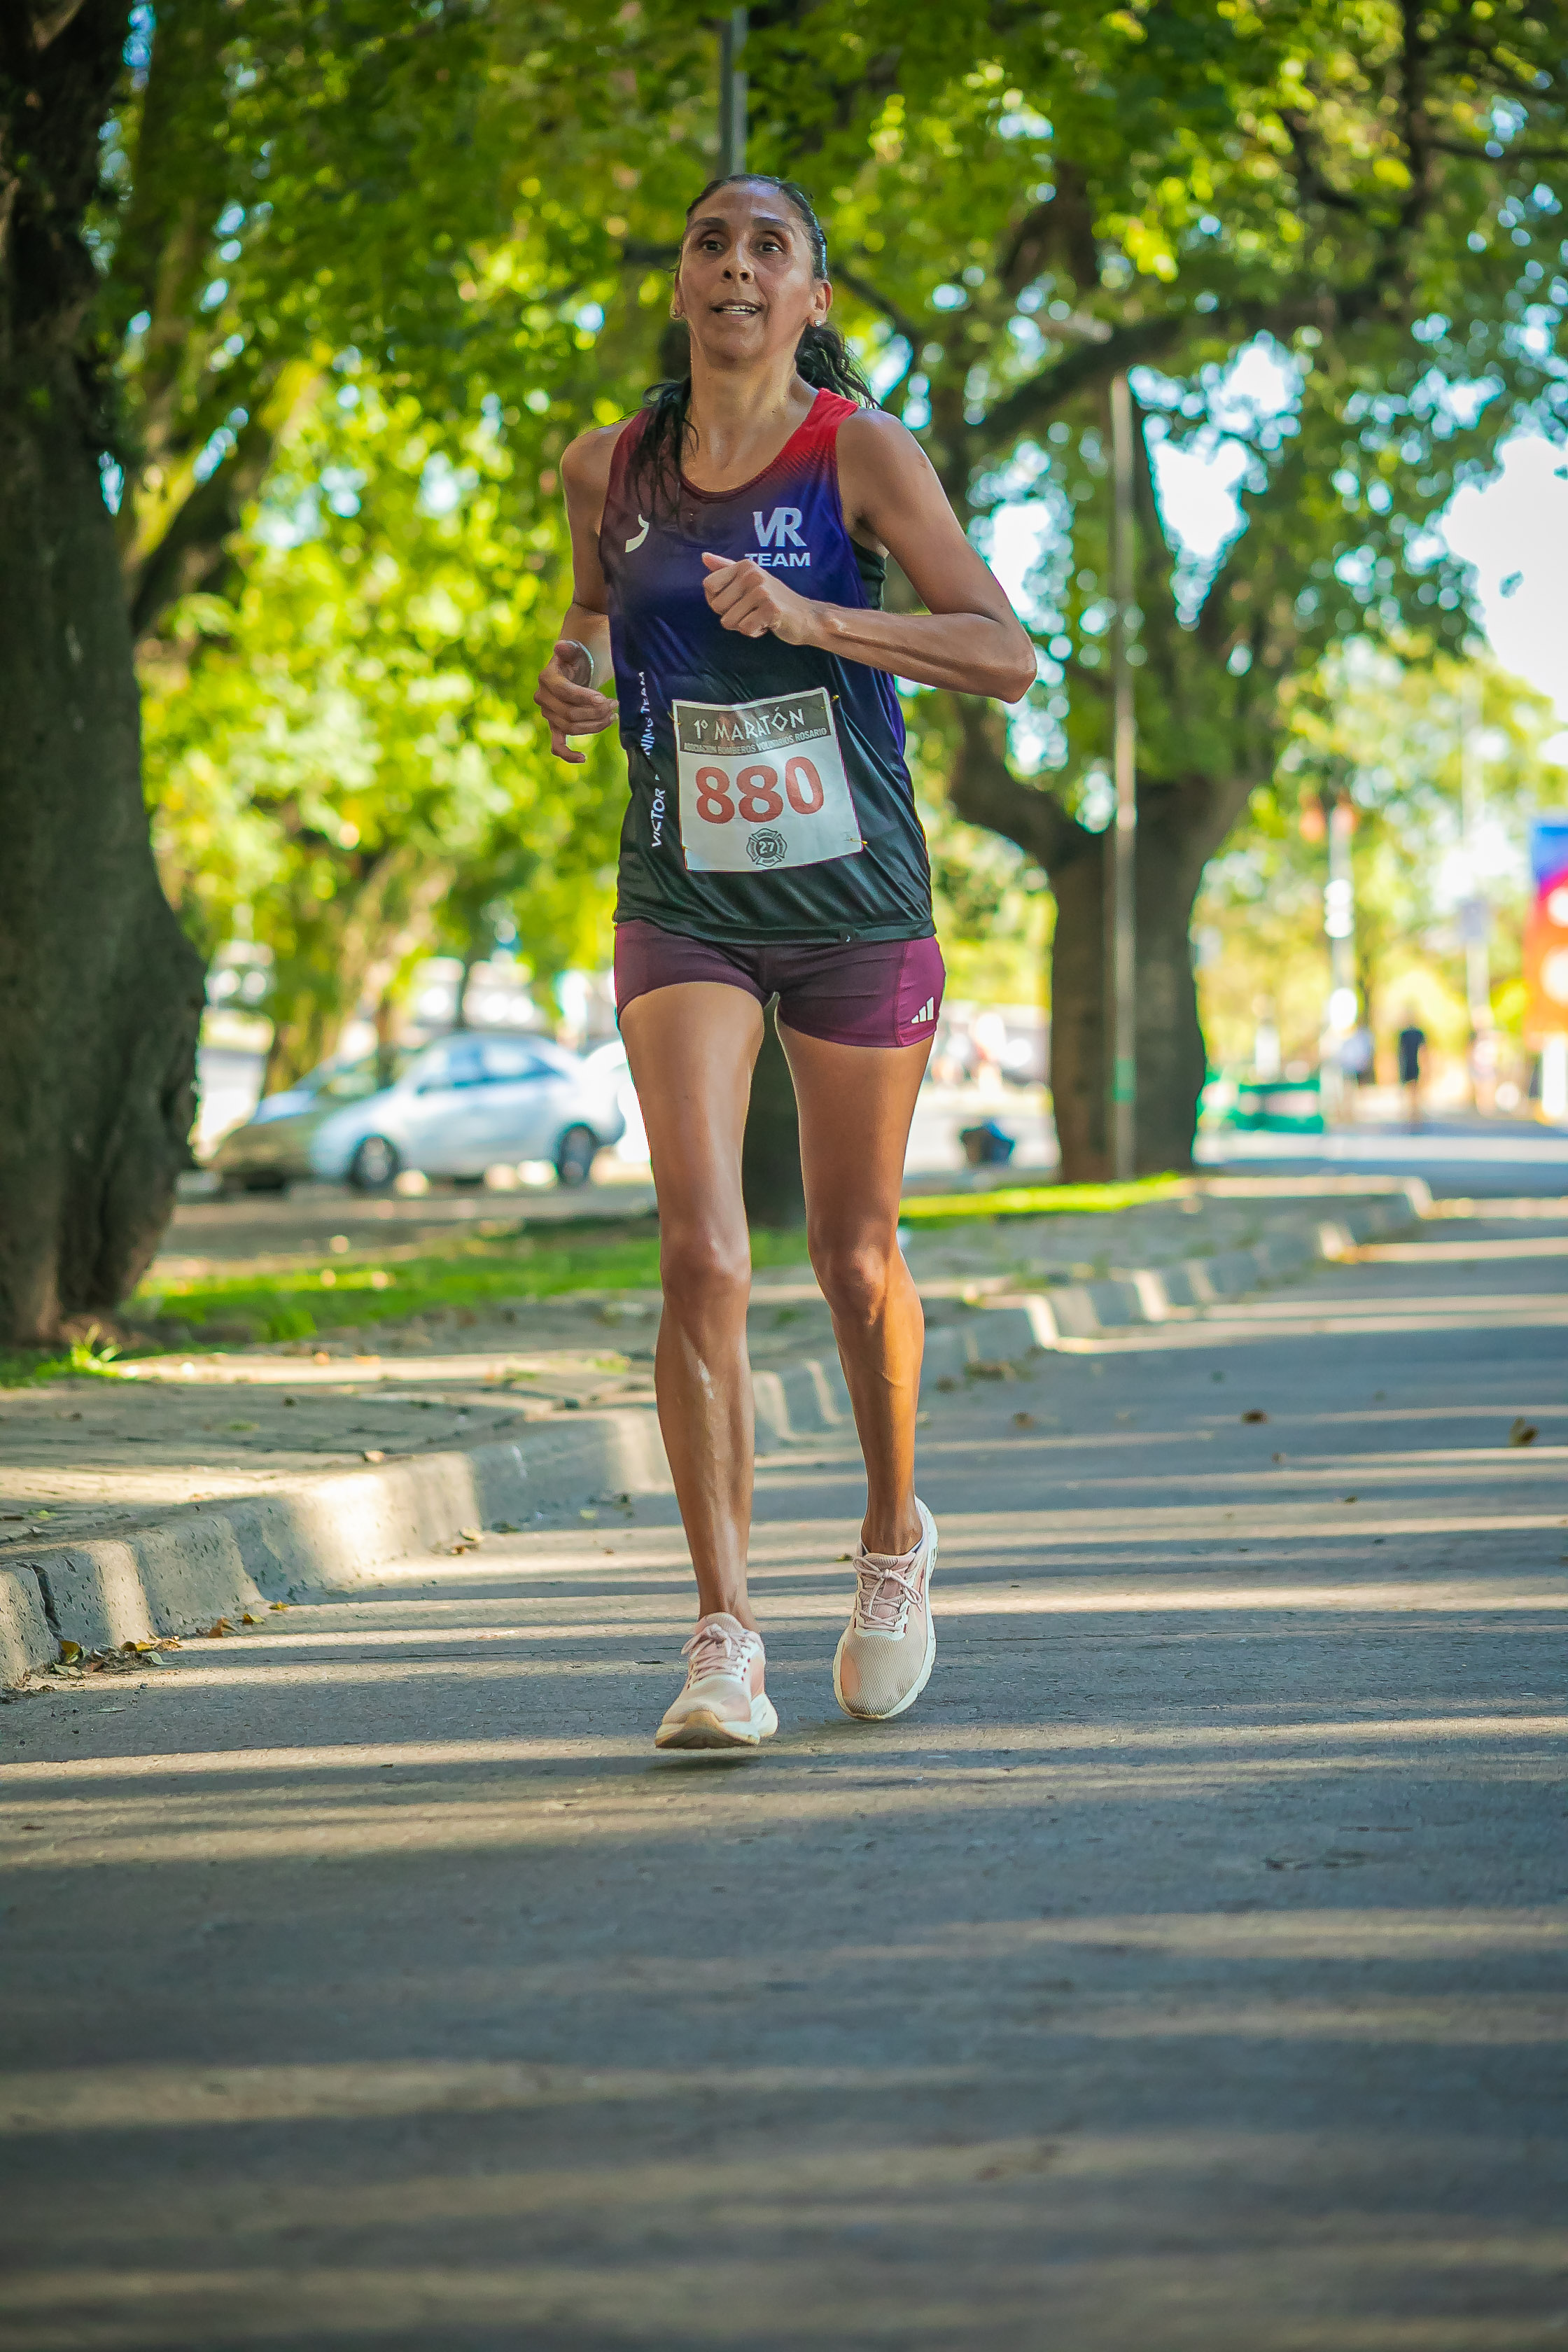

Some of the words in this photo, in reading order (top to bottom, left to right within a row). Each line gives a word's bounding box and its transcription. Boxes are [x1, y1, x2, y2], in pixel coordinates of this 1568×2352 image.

[752, 507, 808, 547] VR
[744, 552, 811, 567] TEAM
[714, 706, 805, 741] MARATÓN
[794, 727, 827, 742] ROSARIO
[695, 756, 825, 825] 880
[652, 788, 666, 847] VICTOR
[759, 841, 775, 854] 27
